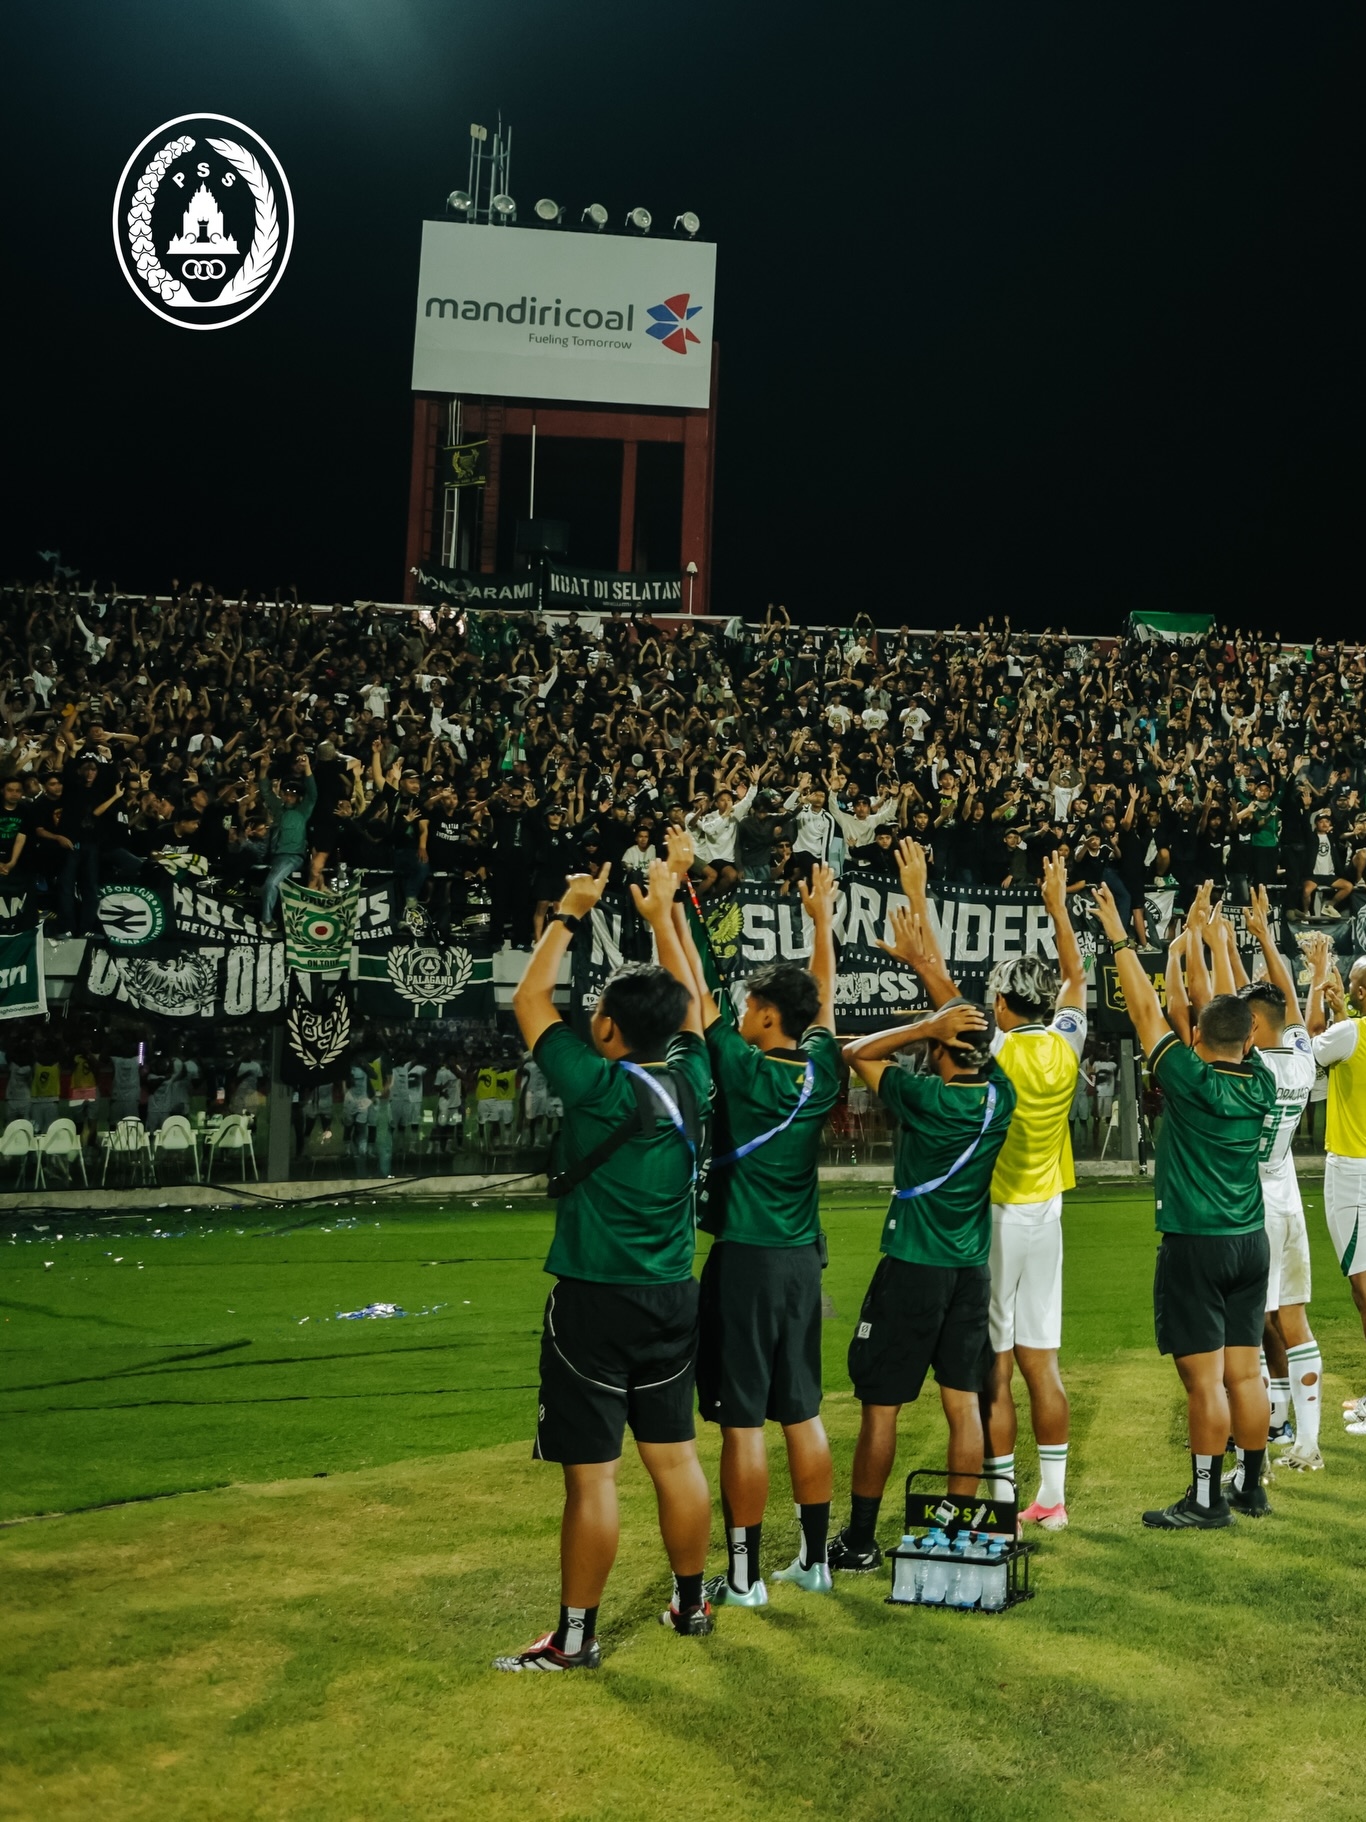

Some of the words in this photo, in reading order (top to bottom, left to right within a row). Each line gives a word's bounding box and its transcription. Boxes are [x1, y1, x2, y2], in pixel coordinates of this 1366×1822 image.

[425, 296, 634, 331] mandiricoal
[528, 333, 568, 347] Fueling
[572, 336, 632, 349] Tomorrow
[551, 573, 589, 597] KUAT
[594, 580, 608, 599] DI
[613, 581, 681, 600] SELATAN
[354, 926, 392, 940] GREEN
[200, 941, 288, 1017] TOU
[861, 967, 918, 1004] PSS
